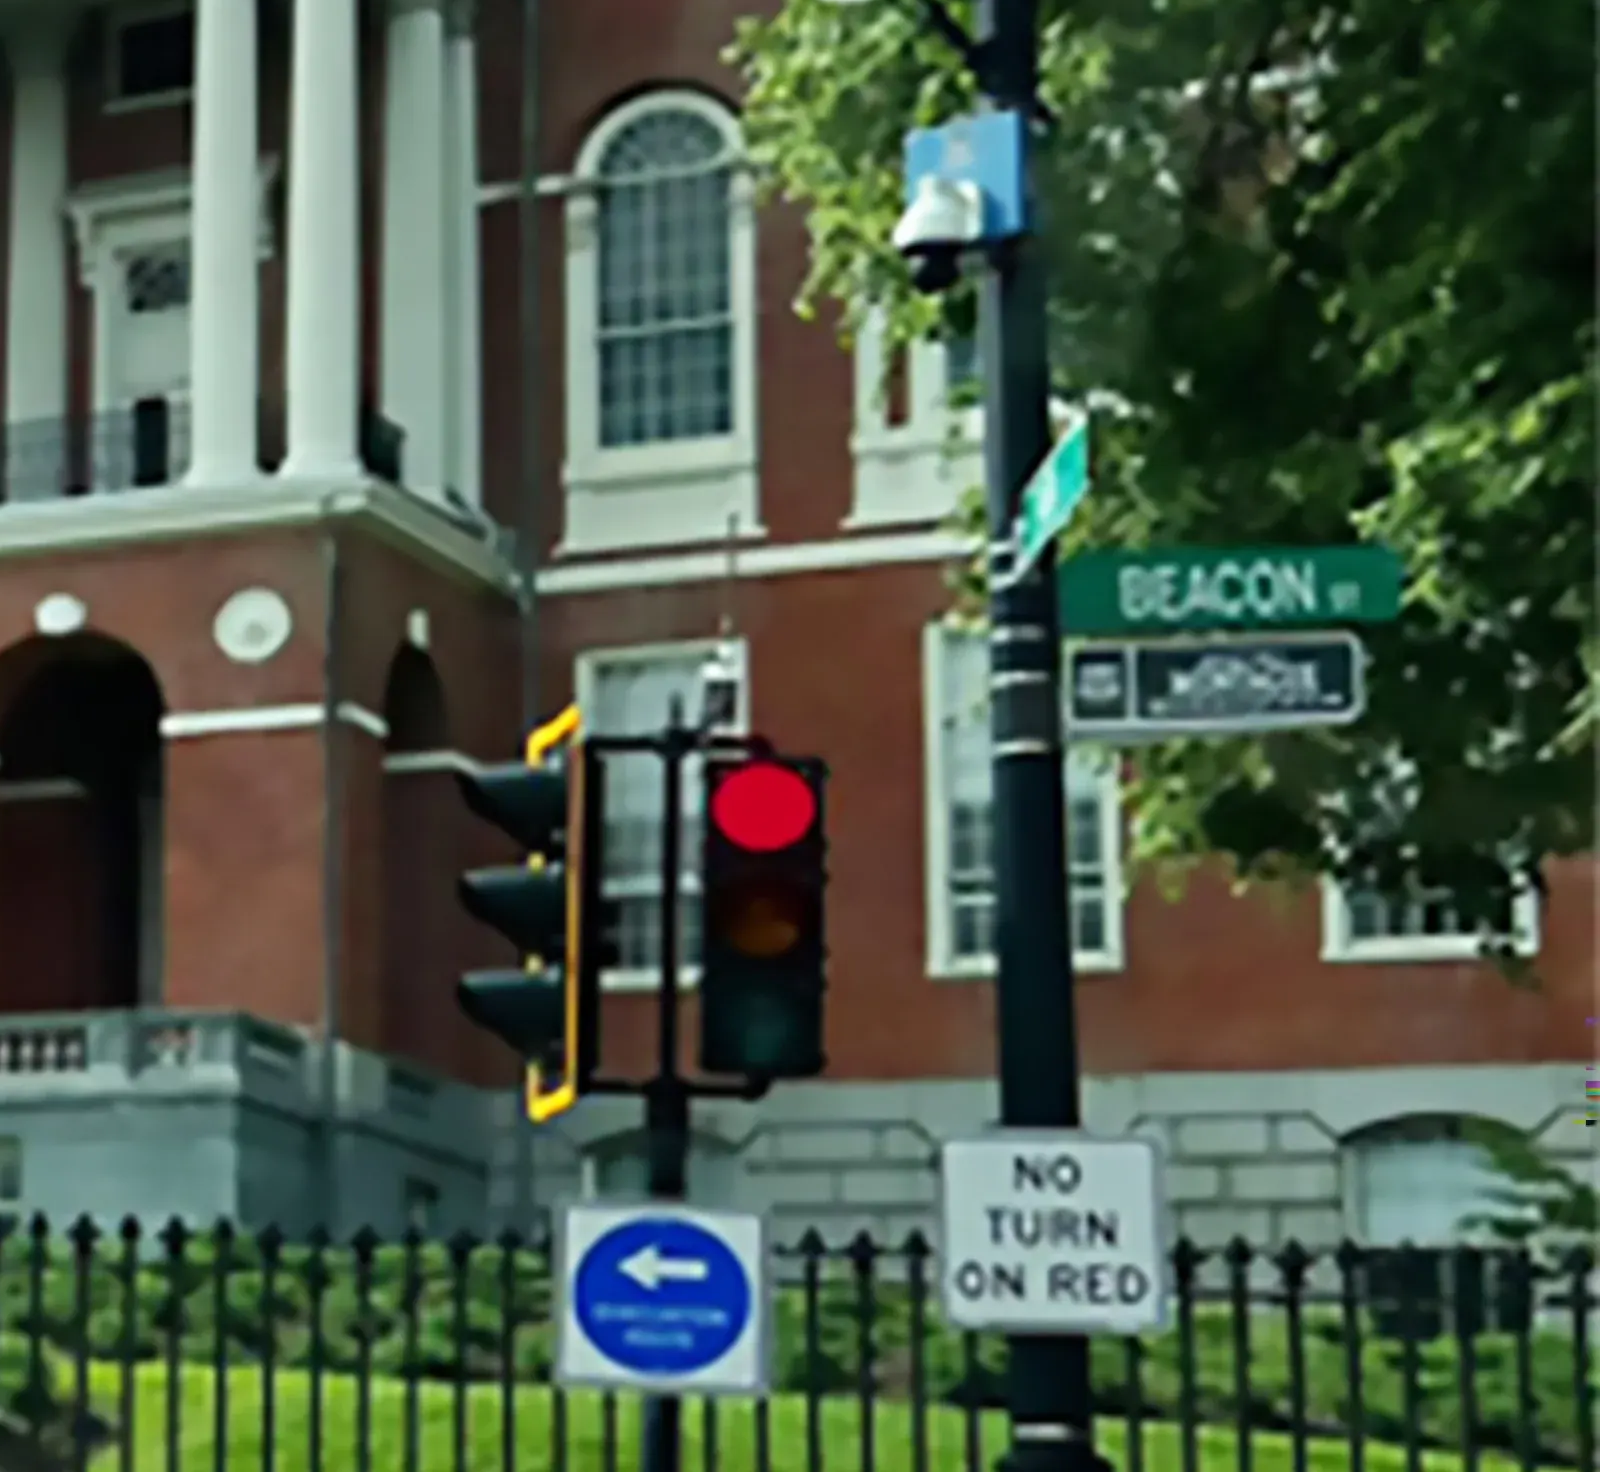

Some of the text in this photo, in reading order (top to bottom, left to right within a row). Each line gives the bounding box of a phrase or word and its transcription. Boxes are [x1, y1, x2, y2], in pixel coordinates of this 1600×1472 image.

[1118, 558, 1316, 620] BEACON
[1012, 1153, 1082, 1195] NO
[985, 1204, 1119, 1248] TURN
[956, 1260, 1149, 1305] ON RED
